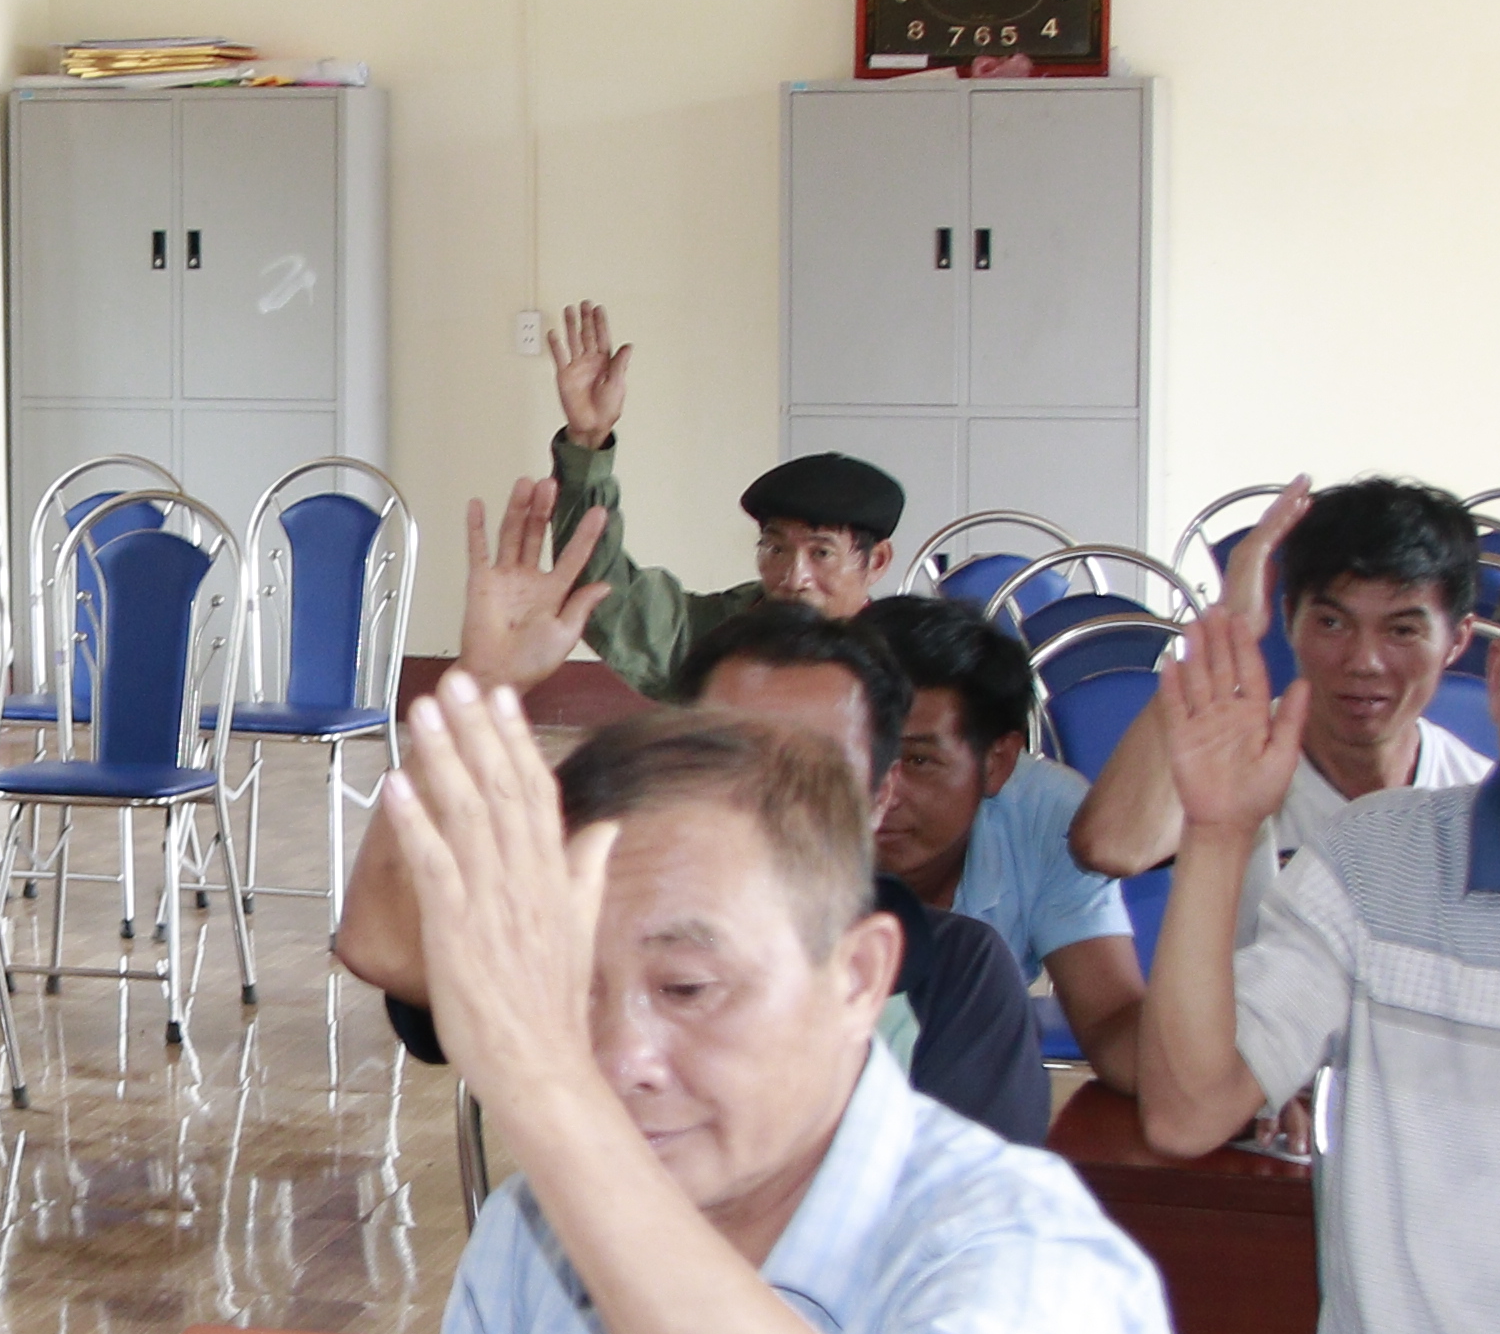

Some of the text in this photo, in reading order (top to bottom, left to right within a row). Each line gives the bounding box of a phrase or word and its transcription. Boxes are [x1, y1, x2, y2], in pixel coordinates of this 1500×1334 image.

[907, 20, 925, 40] 8
[949, 25, 1018, 47] 7 6 5
[1041, 17, 1059, 38] 4
